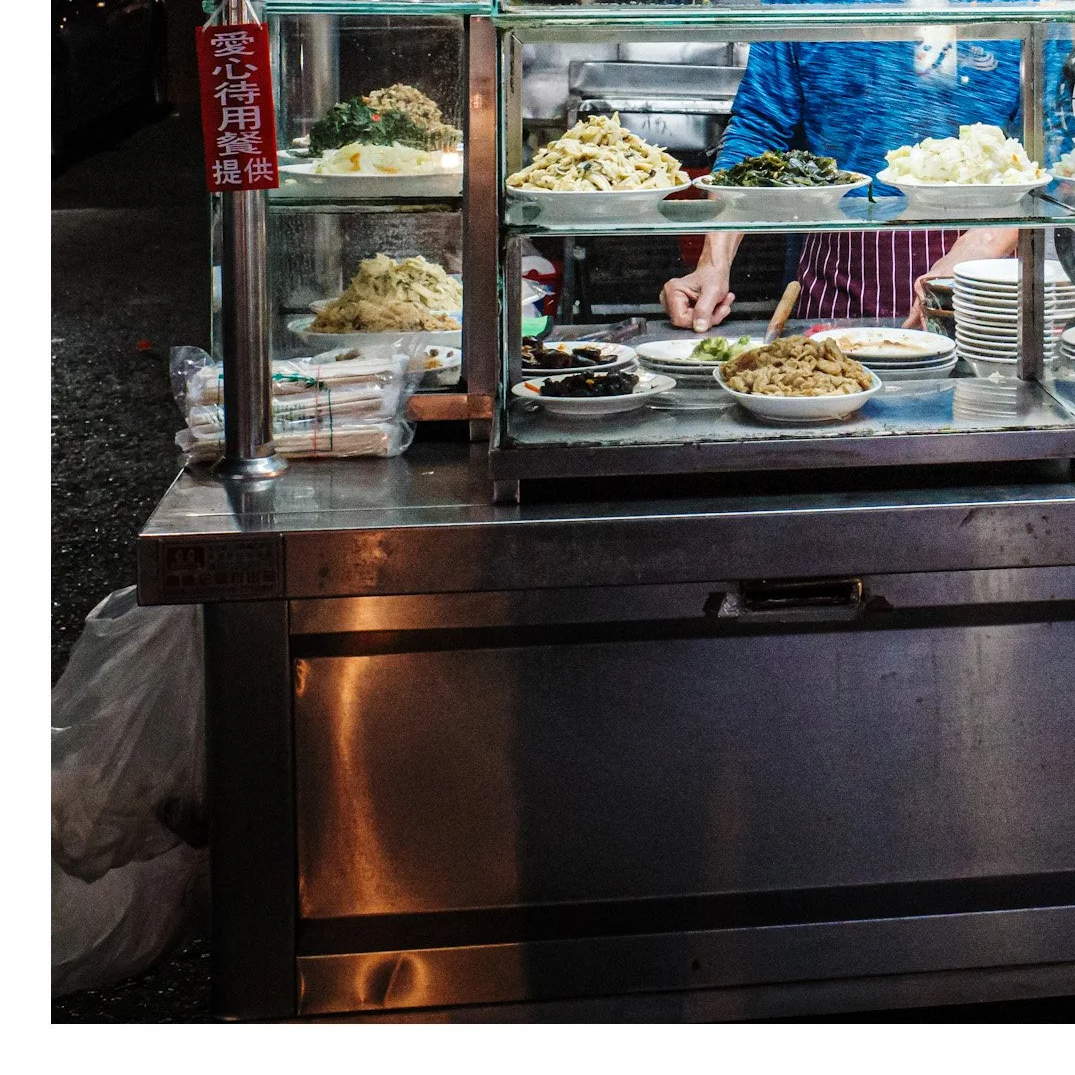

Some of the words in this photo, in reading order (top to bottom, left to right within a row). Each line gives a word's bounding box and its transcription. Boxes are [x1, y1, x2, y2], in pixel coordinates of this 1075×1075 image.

[211, 31, 263, 157] 愛心待用餐
[212, 157, 274, 185] 提供
